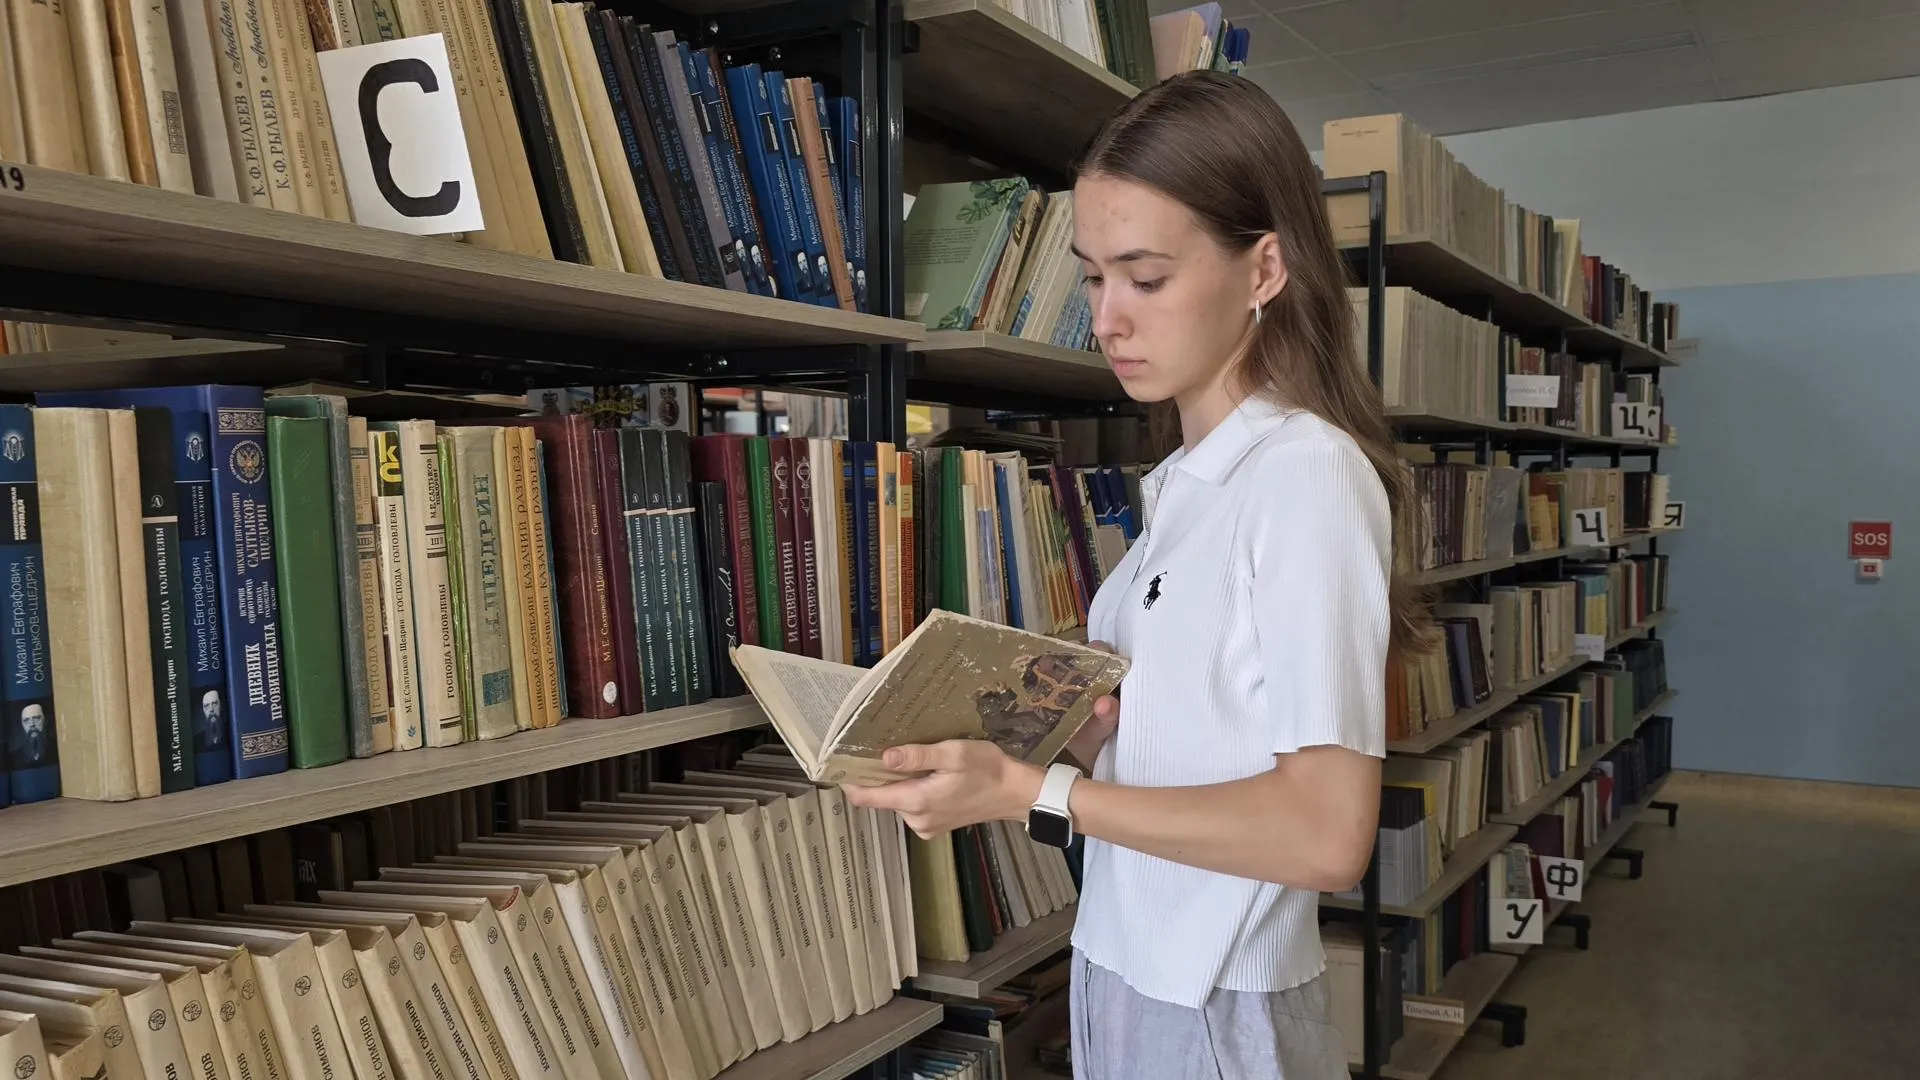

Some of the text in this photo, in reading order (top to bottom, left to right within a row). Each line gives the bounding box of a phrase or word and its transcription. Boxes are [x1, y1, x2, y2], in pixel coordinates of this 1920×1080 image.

[358, 57, 461, 218] С
[739, 203, 751, 233] Михаил
[786, 211, 798, 241] Михаил
[807, 215, 819, 244] Михаил
[1619, 406, 1645, 435] Ц
[17, 499, 27, 540] ПРАВДА
[197, 485, 208, 536] КОЛЛЕКЦИЯ
[232, 492, 245, 575] МИХАИЛ ЕВГРАФОВИЧ
[243, 493, 259, 567] САЛТЫКОВ-
[257, 504, 271, 560] ЩЕДРИН
[591, 504, 599, 535] Сказки
[1576, 511, 1605, 543] Ч
[1664, 503, 1683, 526] Я
[1853, 532, 1888, 546] SOS
[155, 527, 169, 595] ГОЛОВЛЕВЫ
[388, 503, 405, 613] ГОСПОДА ГОЛОВЛЕВЫ
[512, 444, 544, 712] НИКОЛАЙ САМВЕЛЯН КАЗАЧИЙ РАЗЪЕЗД
[528, 445, 559, 710] НИКОЛАЙ САМВЕЛЯН КАЗАЧИЙ РАЗЪЕЗД
[639, 569, 648, 607] ГОСПОДА
[659, 568, 669, 605] ГОСПОДА
[683, 567, 692, 604] ГОСПОДА
[9, 562, 29, 683] Михаил Евграфович
[24, 555, 45, 682] САЛТЫКОВ-ЩЕДРИН
[161, 599, 173, 649] ГОСПОДА
[191, 556, 209, 672] Михаил Евграфович
[203, 550, 221, 670] САЛТЫКОВ-ЩЕДРИН
[238, 587, 247, 617] ИСТОРИЯ
[256, 586, 264, 614] ГОСПОДА
[361, 560, 376, 639] ГОЛОВЛЕВЫ
[263, 621, 283, 721] ПРОВИНЦИАЛА
[438, 583, 455, 699] ГОСПОДА ГОЛОВЛЕВЫ
[245, 642, 267, 706] ДНЕВНИК
[369, 644, 383, 709] ГОСПОДА
[785, 852, 811, 947] КОНСТАНТИН СИМОНОВ
[839, 835, 858, 930] КОНСТАНТИН СИМОНОВ
[1546, 862, 1579, 896] Ф
[663, 903, 696, 999] КОНСТАНТИН СИМОНОВ
[676, 888, 711, 986] КОНСТАНТИН СИМОНОВ
[726, 871, 756, 968] КОНСТАНТИН СИМОНОВ
[1506, 902, 1539, 940] У
[608, 933, 646, 1031] КОНСТАНТИН СИМОНОВ
[644, 902, 679, 1002] КОНСТАНТИН СИМОНОВ
[430, 982, 456, 1031] СИМОНОВ
[466, 985, 490, 1032] СИМОНОВ
[502, 965, 550, 1072] КОНСТАНТИН СИМОНОВ
[531, 952, 576, 1056] КОНСТАНТИН СИМОНОВ
[556, 945, 600, 1048] КОНСТАНТИН СИМОНОВ
[608, 980, 631, 1038] КОНСТАНТИН
[642, 958, 665, 1016] КОНСТАНТИН
[358, 1015, 384, 1071] СИМОНОВ
[404, 999, 430, 1048] СИМОНОВ
